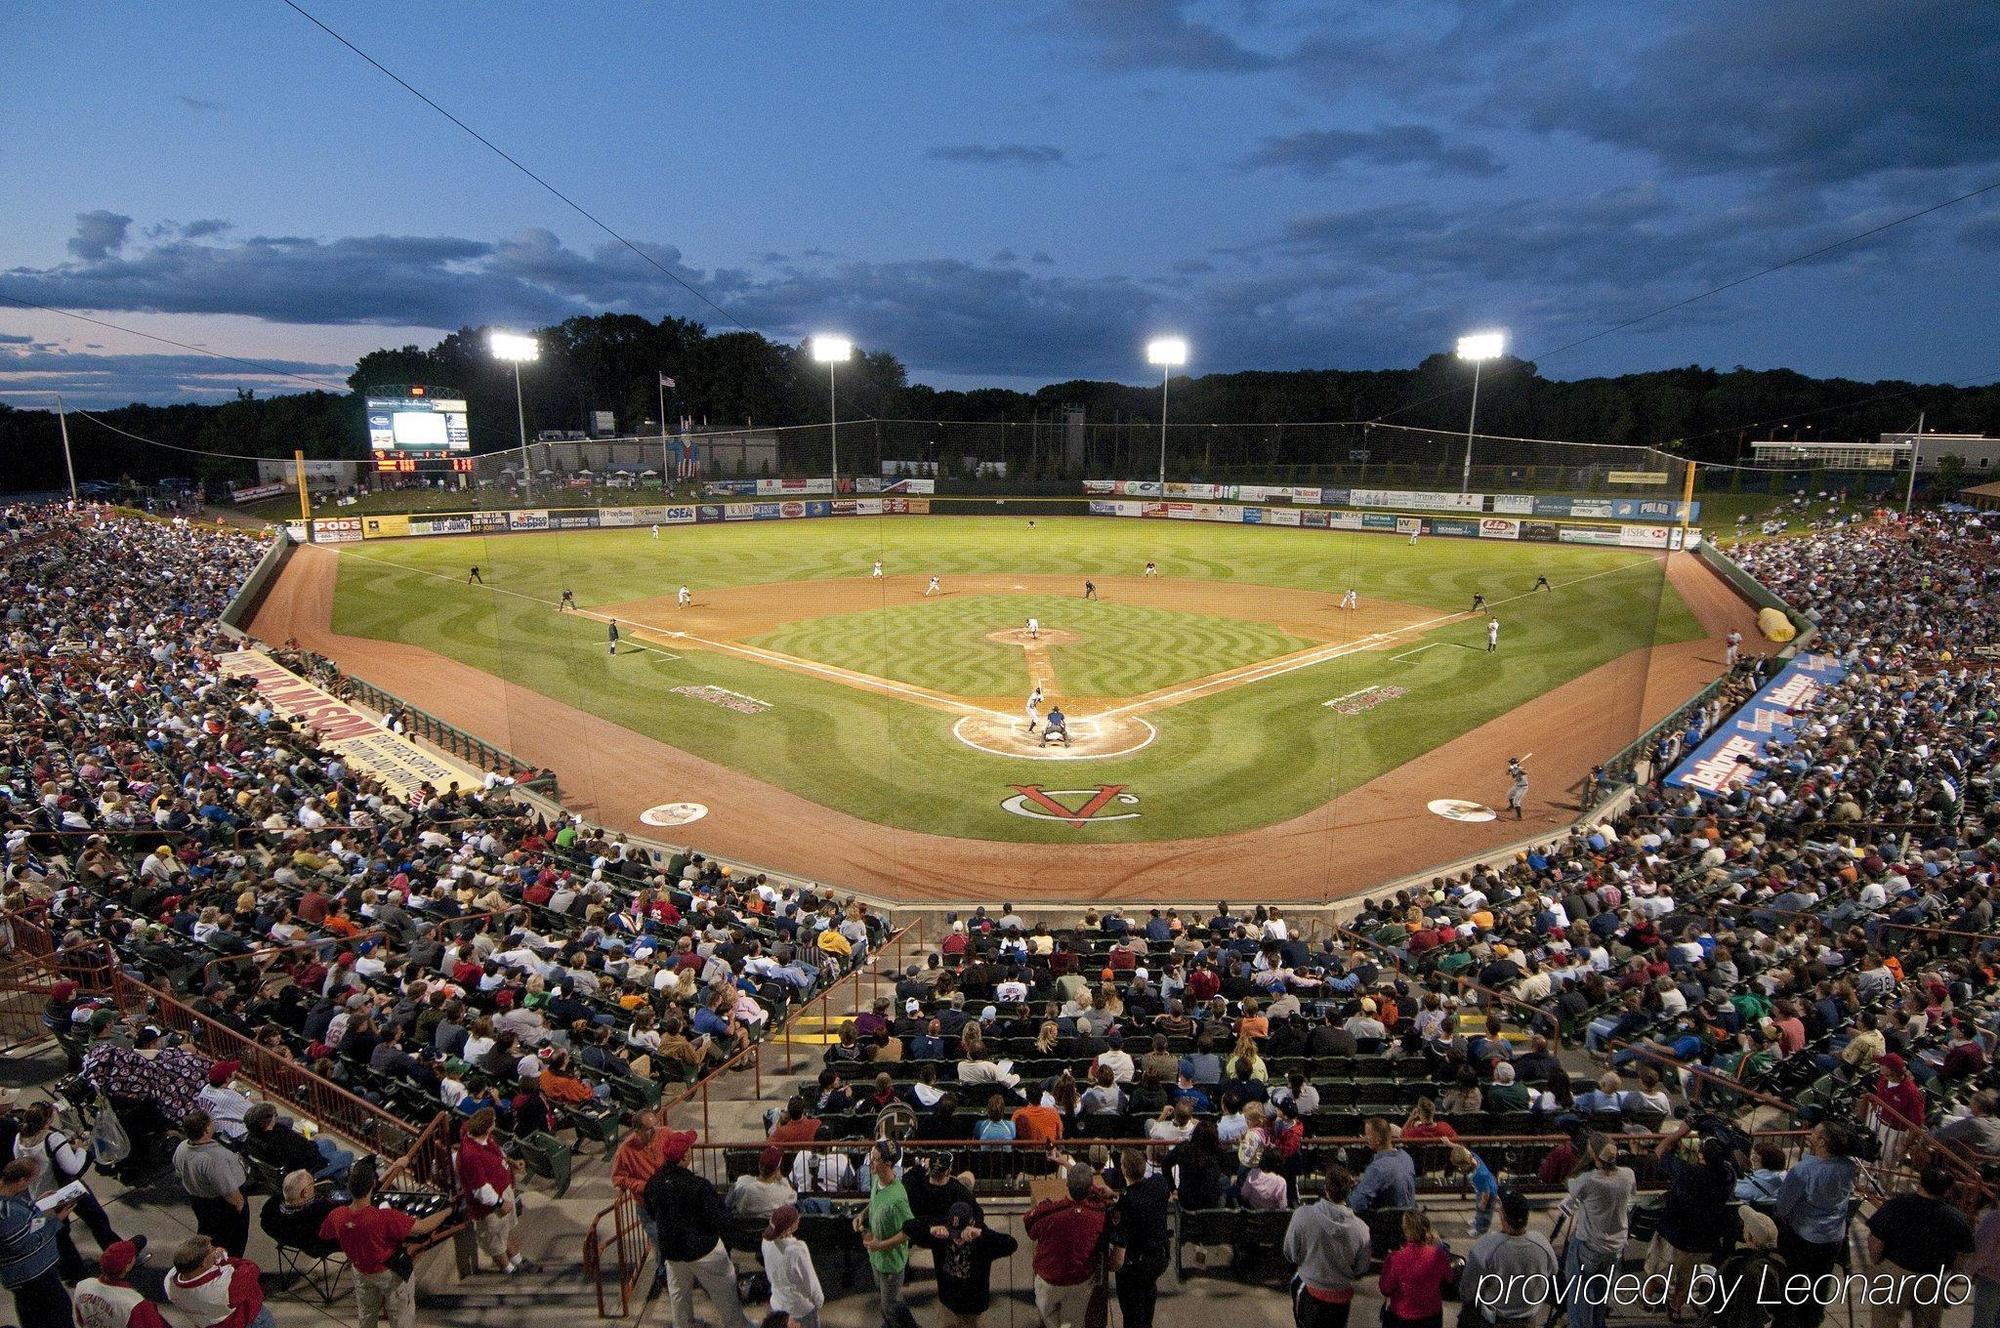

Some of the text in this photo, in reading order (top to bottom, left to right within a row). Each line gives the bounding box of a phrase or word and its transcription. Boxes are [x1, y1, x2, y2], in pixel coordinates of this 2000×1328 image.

[1640, 502, 1668, 514] POLAR
[315, 520, 361, 531] PODS
[1621, 526, 1649, 537] HSBC
[267, 688, 384, 742] MASON
